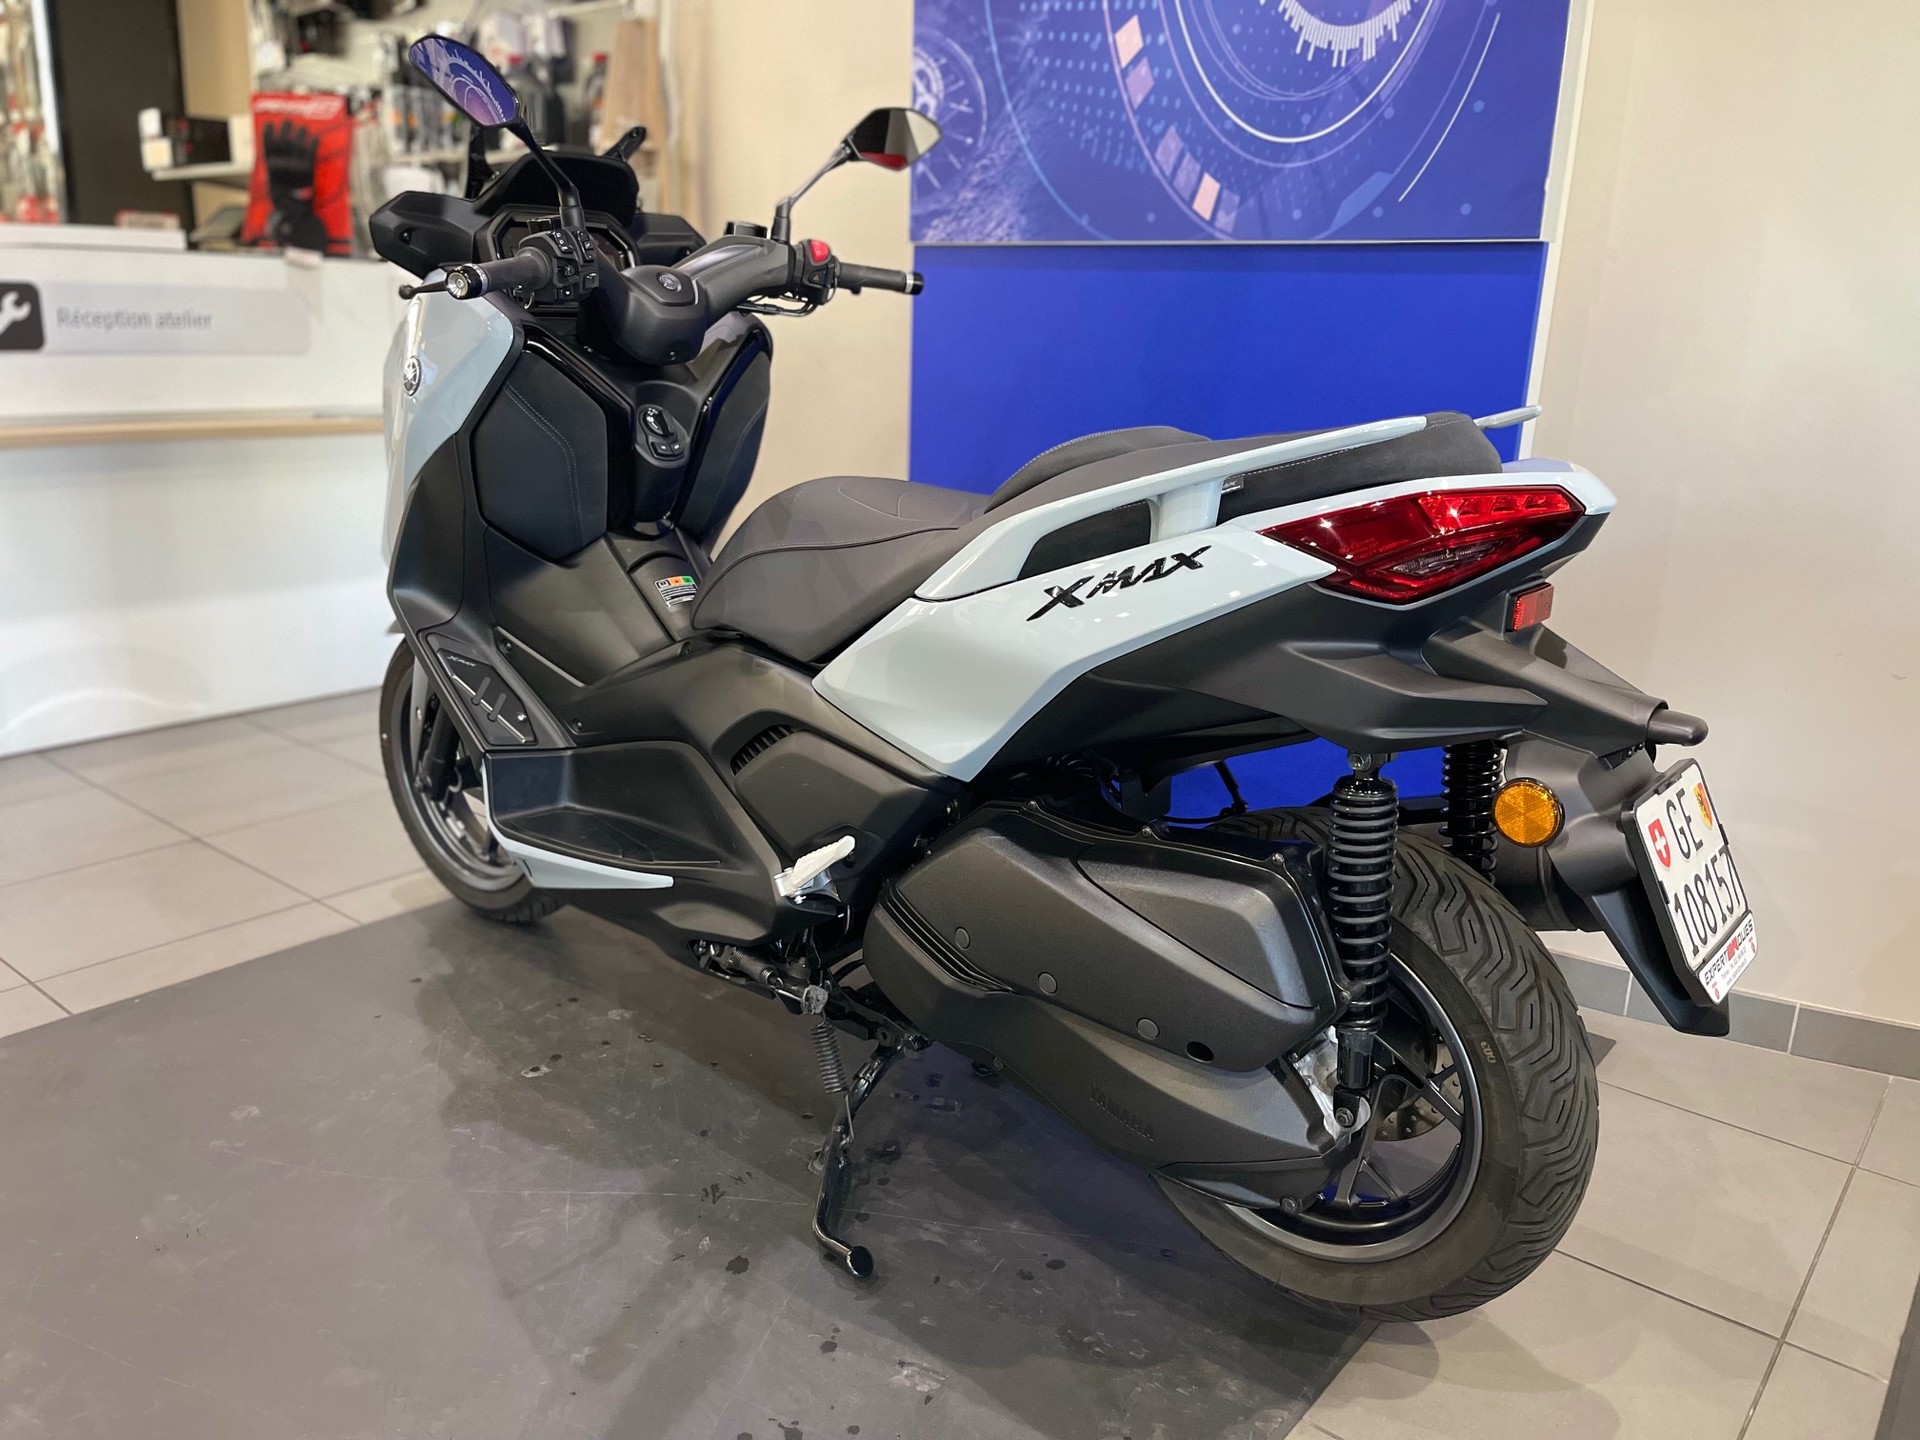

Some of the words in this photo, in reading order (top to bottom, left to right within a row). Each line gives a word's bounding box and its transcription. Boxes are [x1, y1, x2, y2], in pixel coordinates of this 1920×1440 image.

[56, 306, 151, 331] Réception
[155, 309, 213, 329] atelier
[1666, 787, 1704, 860] GE
[1674, 845, 1741, 957] 108157
